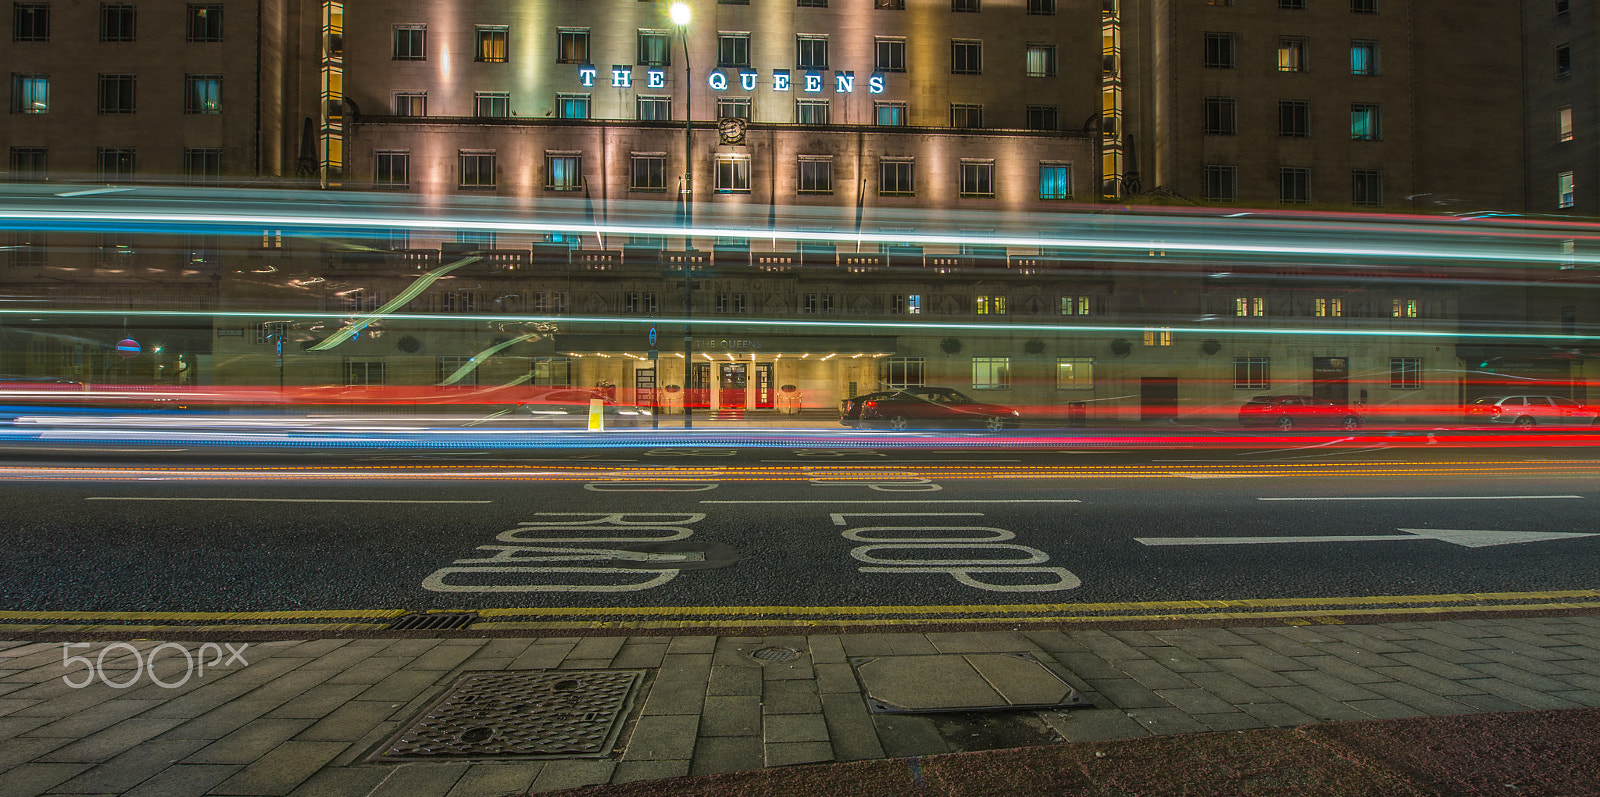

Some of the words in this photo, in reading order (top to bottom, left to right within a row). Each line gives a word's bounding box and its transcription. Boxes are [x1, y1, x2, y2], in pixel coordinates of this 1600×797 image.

[580, 69, 665, 88] THE
[709, 73, 885, 92] QUEENS
[695, 340, 716, 349] THE
[721, 340, 761, 350] QUEENS
[423, 512, 706, 593] ROAD
[829, 512, 1082, 592] LOOP
